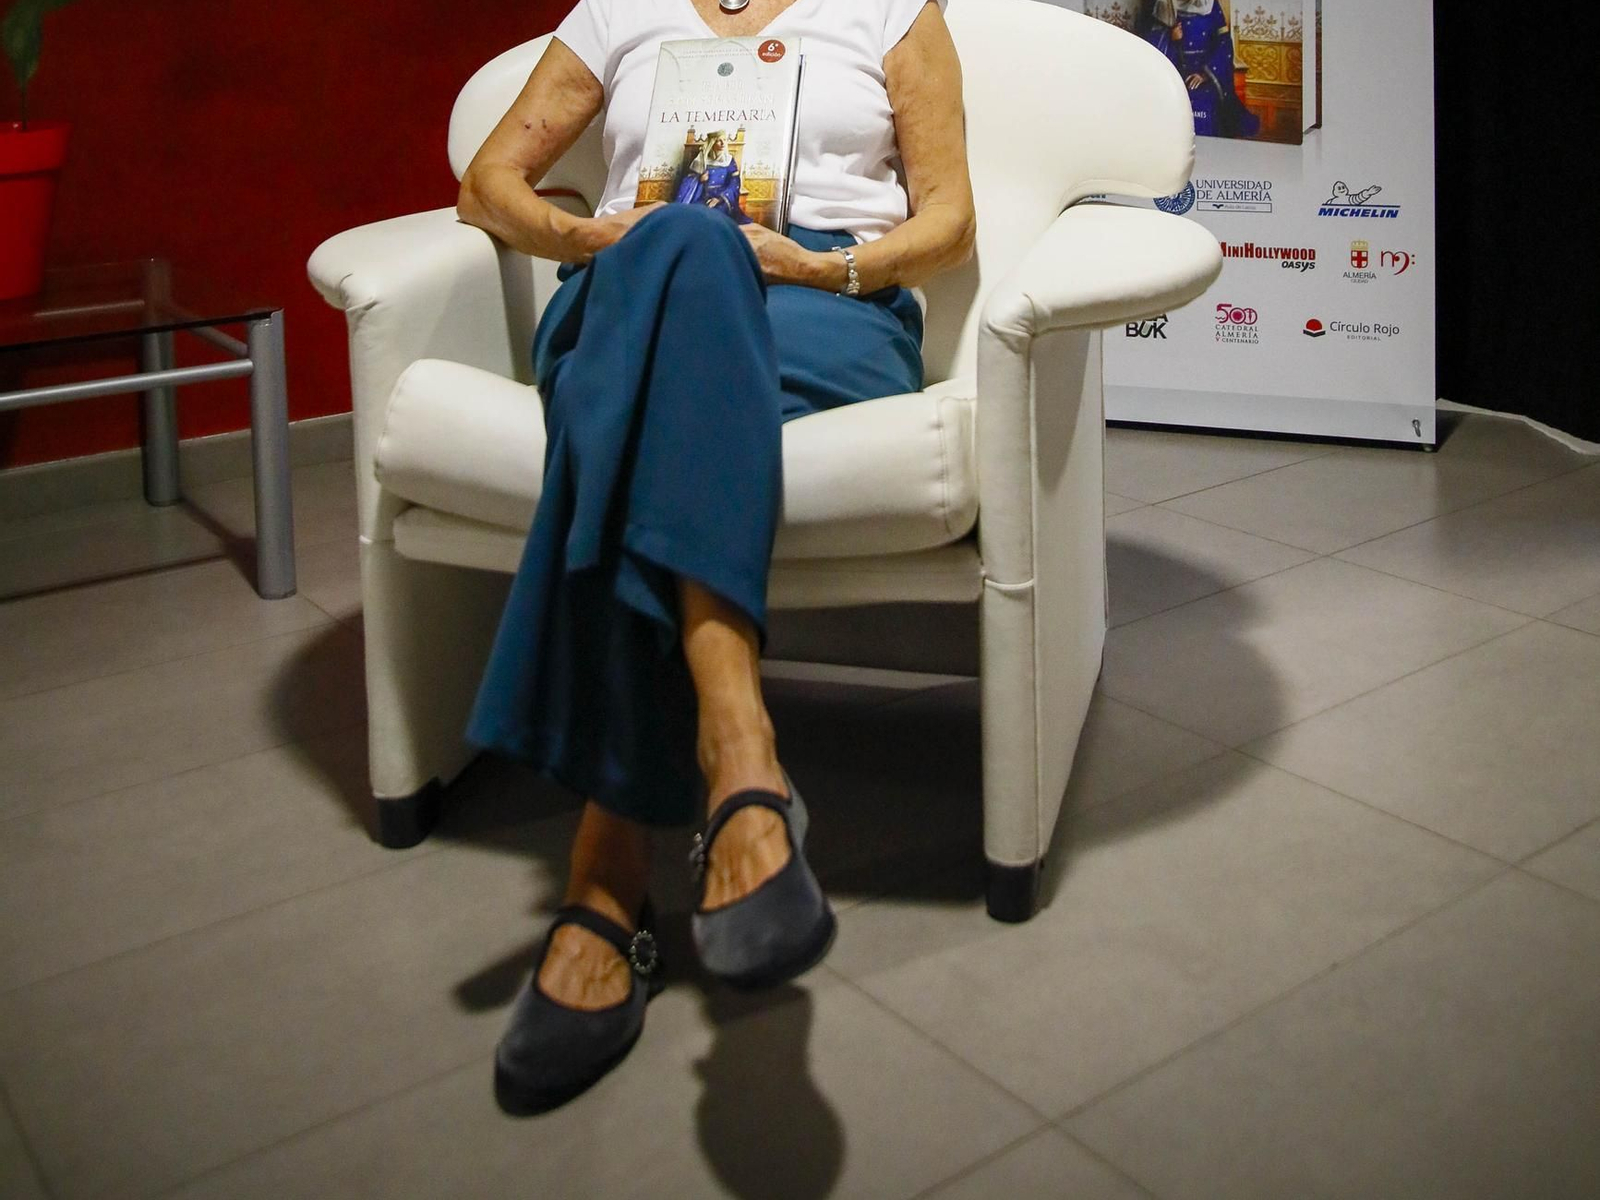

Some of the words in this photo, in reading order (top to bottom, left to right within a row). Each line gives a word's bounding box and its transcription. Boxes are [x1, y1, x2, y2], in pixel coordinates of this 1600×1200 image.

[660, 111, 680, 124] LA
[686, 108, 777, 123] TEMERARIA
[1196, 179, 1272, 191] UNIVERSIDAD
[1196, 189, 1212, 200] DE
[1216, 189, 1272, 201] ALMERÍA
[1317, 206, 1400, 219] MICHELIN
[1343, 271, 1377, 280] ALMERÍA
[1215, 303, 1258, 325] 500
[1125, 320, 1167, 340] BUK
[1215, 324, 1258, 332] CATEDRAL
[1329, 321, 1370, 333] Círculo
[1374, 323, 1400, 337] Rojo
[1215, 331, 1258, 339] ALMERÍA
[1221, 337, 1259, 345] CENTENARIO
